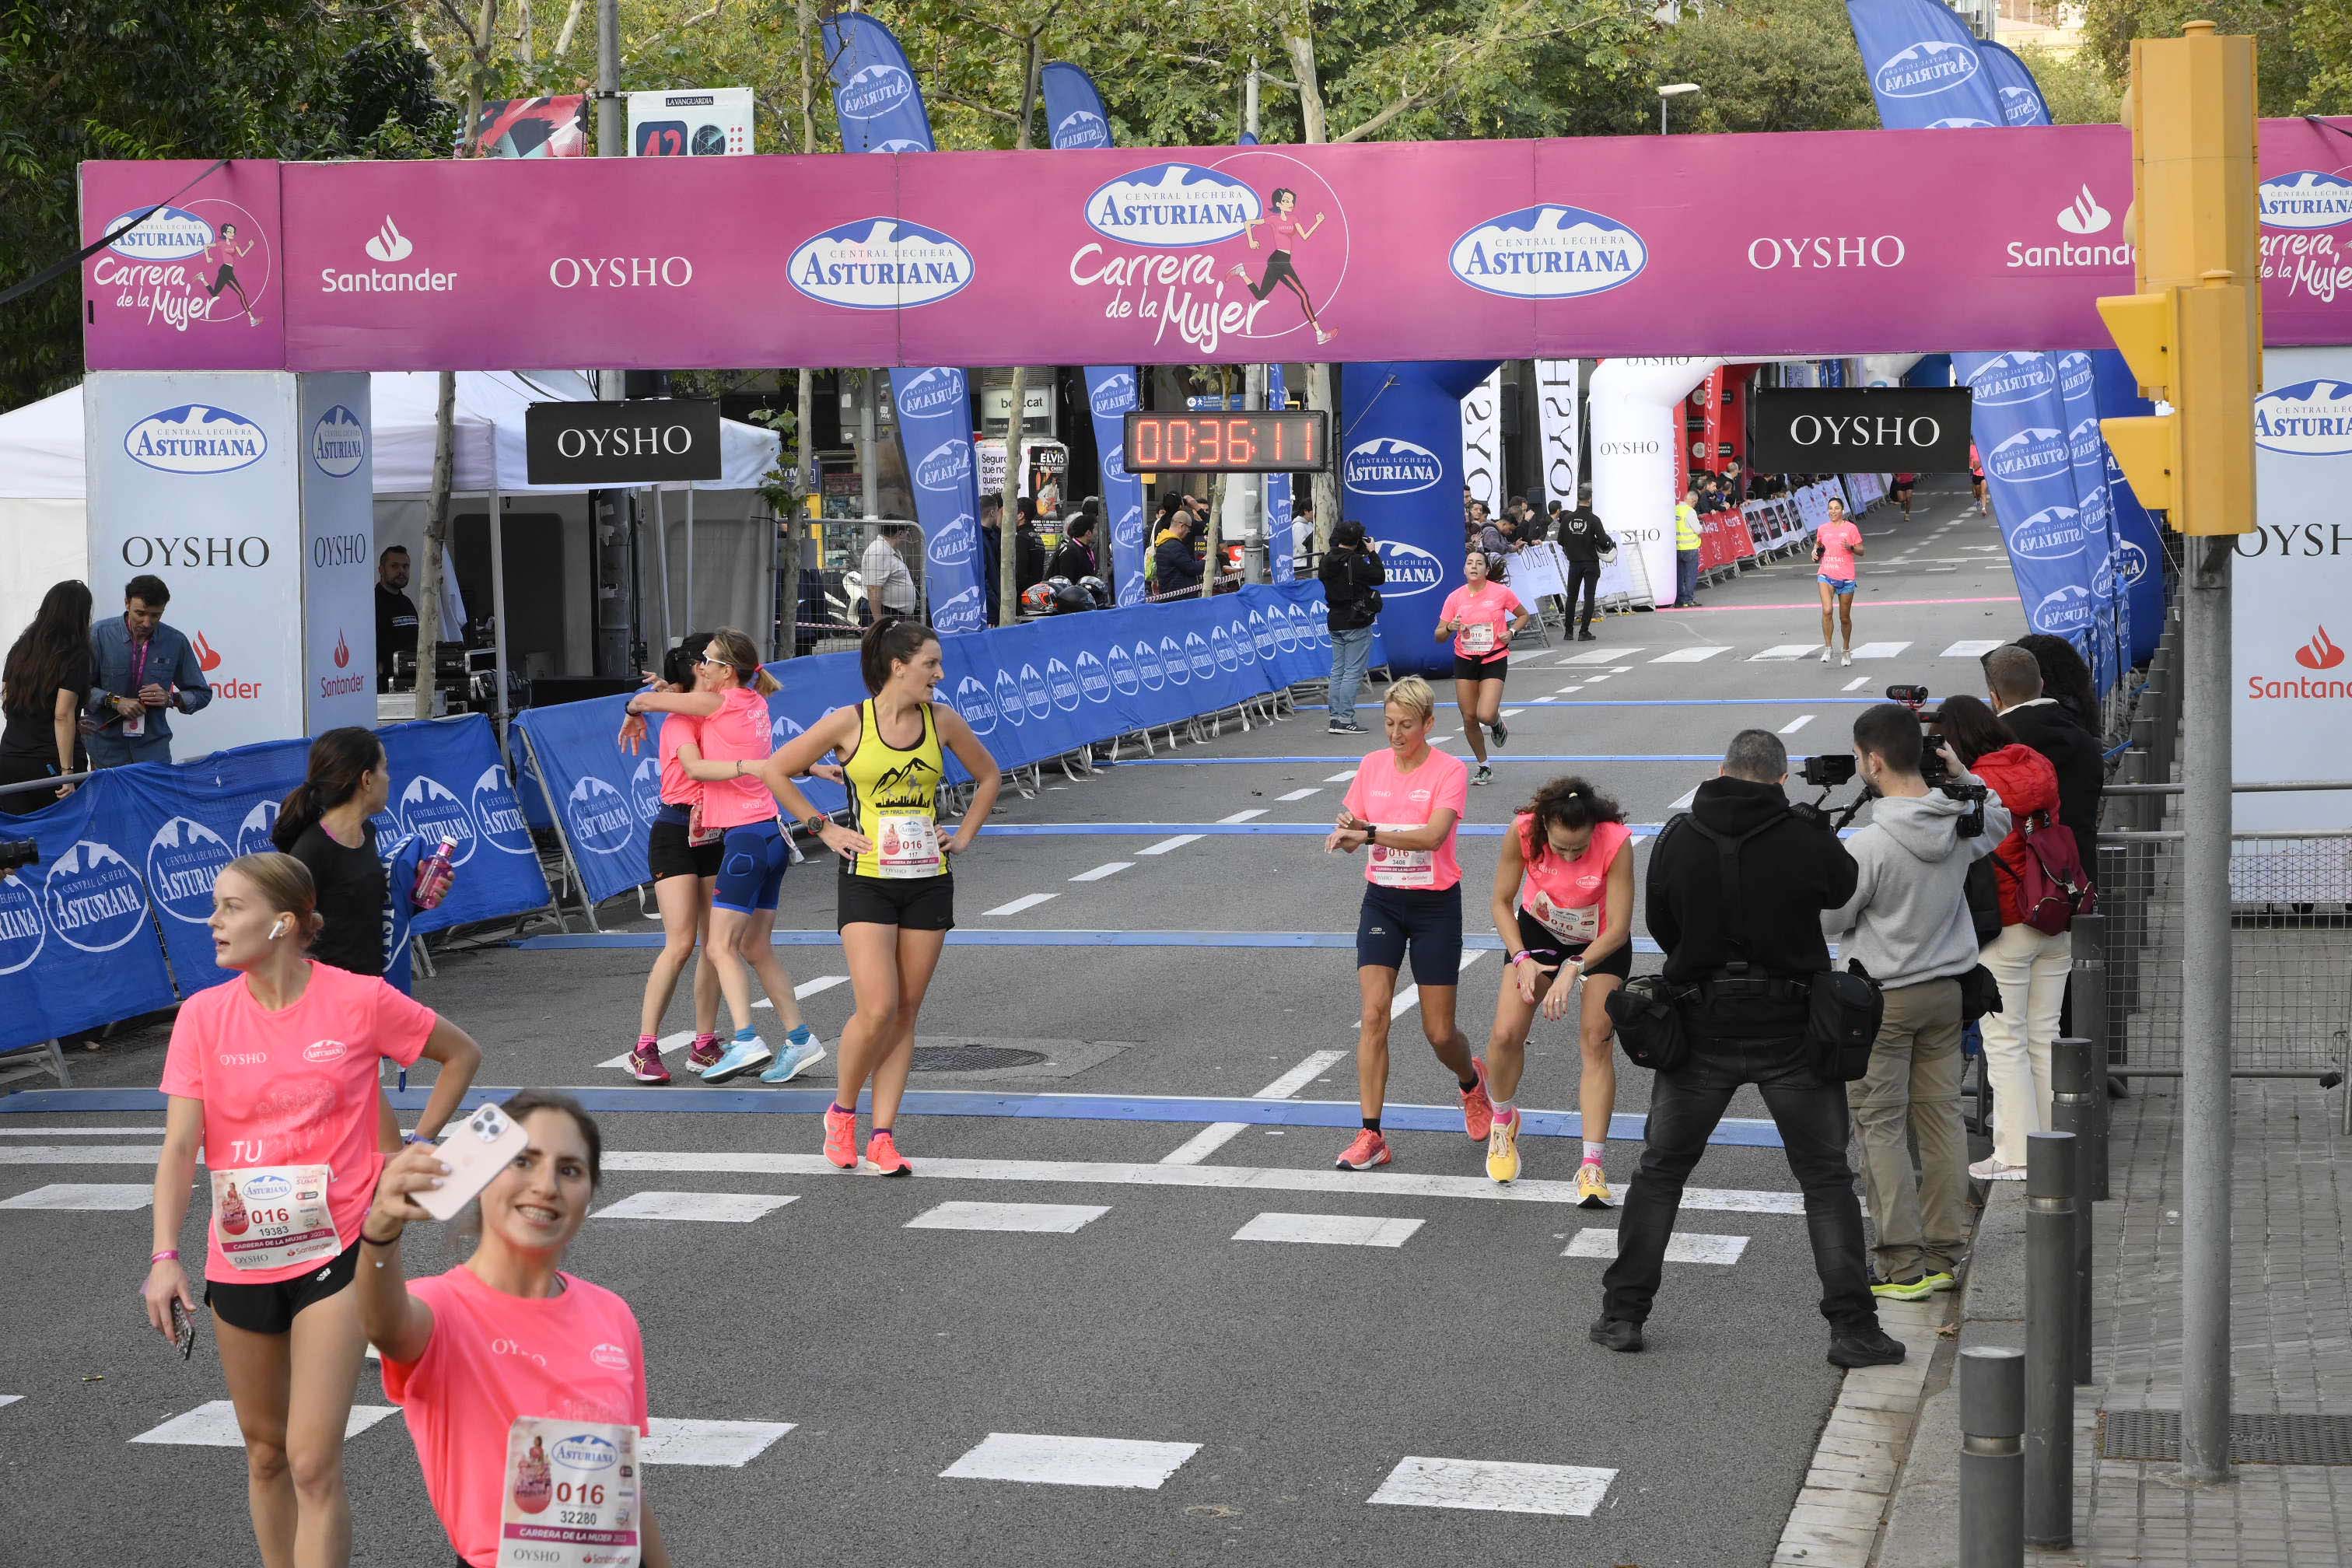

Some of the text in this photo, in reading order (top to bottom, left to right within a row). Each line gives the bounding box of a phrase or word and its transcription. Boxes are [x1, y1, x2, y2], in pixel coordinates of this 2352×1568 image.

[1126, 191, 1244, 201] CENTRAL LECHERA
[1097, 195, 1248, 226] ASTURIANA
[1496, 236, 1626, 247] CENTRAL LECHERA
[1748, 235, 1906, 269] OYSHO
[2259, 234, 2333, 256] arrera
[831, 248, 954, 258] CENTRAL LECHERA
[1465, 241, 1631, 275] ASTURIANA
[94, 257, 185, 286] Carrera
[549, 257, 692, 289] OYSHO
[801, 251, 960, 286] ASTURIANA
[1070, 243, 1214, 286] Carrera
[322, 268, 457, 292] Santander
[2277, 257, 2291, 278] la
[2288, 252, 2352, 303] Muje
[117, 284, 219, 331] de la Mujer
[1106, 281, 1269, 353] de la Mujer
[558, 425, 692, 458] OYSHO
[1790, 415, 1940, 446] OYSHO
[136, 430, 257, 456] ASTURIANA
[317, 429, 361, 460] ASTURIANA
[1138, 420, 1311, 464] 00:36:11
[1600, 441, 1659, 456] OYSHO
[1041, 453, 1063, 463] ELVIS
[982, 467, 995, 475] que
[1347, 461, 1434, 482] ASTURIANA
[1624, 529, 1661, 542] SHO
[2232, 523, 2352, 557] OYSH
[122, 537, 270, 567] OYSHO
[315, 534, 366, 568] OYSHO
[1384, 569, 1435, 583] RIANA
[320, 674, 364, 699] Santander
[413, 804, 460, 818] CENTRAL LECHERA
[408, 814, 473, 846] ASTURIANA
[903, 841, 922, 849] 016
[166, 848, 225, 867] CENTRAL LECHERA
[62, 879, 95, 893] CENTRAL
[157, 862, 228, 901] ASTURIA
[54, 884, 142, 930] ASTURIANA
[1551, 919, 1573, 930] 016
[219, 1052, 266, 1066] OYSHO
[230, 1140, 263, 1163] TU
[247, 1185, 288, 1195] ASTURIANA
[251, 1209, 289, 1224] 016
[259, 1226, 289, 1237] 19383
[285, 1235, 307, 1244] MUJER
[235, 1255, 268, 1264] OYSHO
[553, 1447, 612, 1464] ASTURIANA
[557, 1482, 604, 1505] 016
[560, 1510, 597, 1525] 32280
[520, 1528, 561, 1540] CARRERA
[563, 1530, 576, 1541] DE
[576, 1531, 586, 1541] LA
[588, 1531, 612, 1542] MUJER
[514, 1549, 560, 1563] OYSHO
